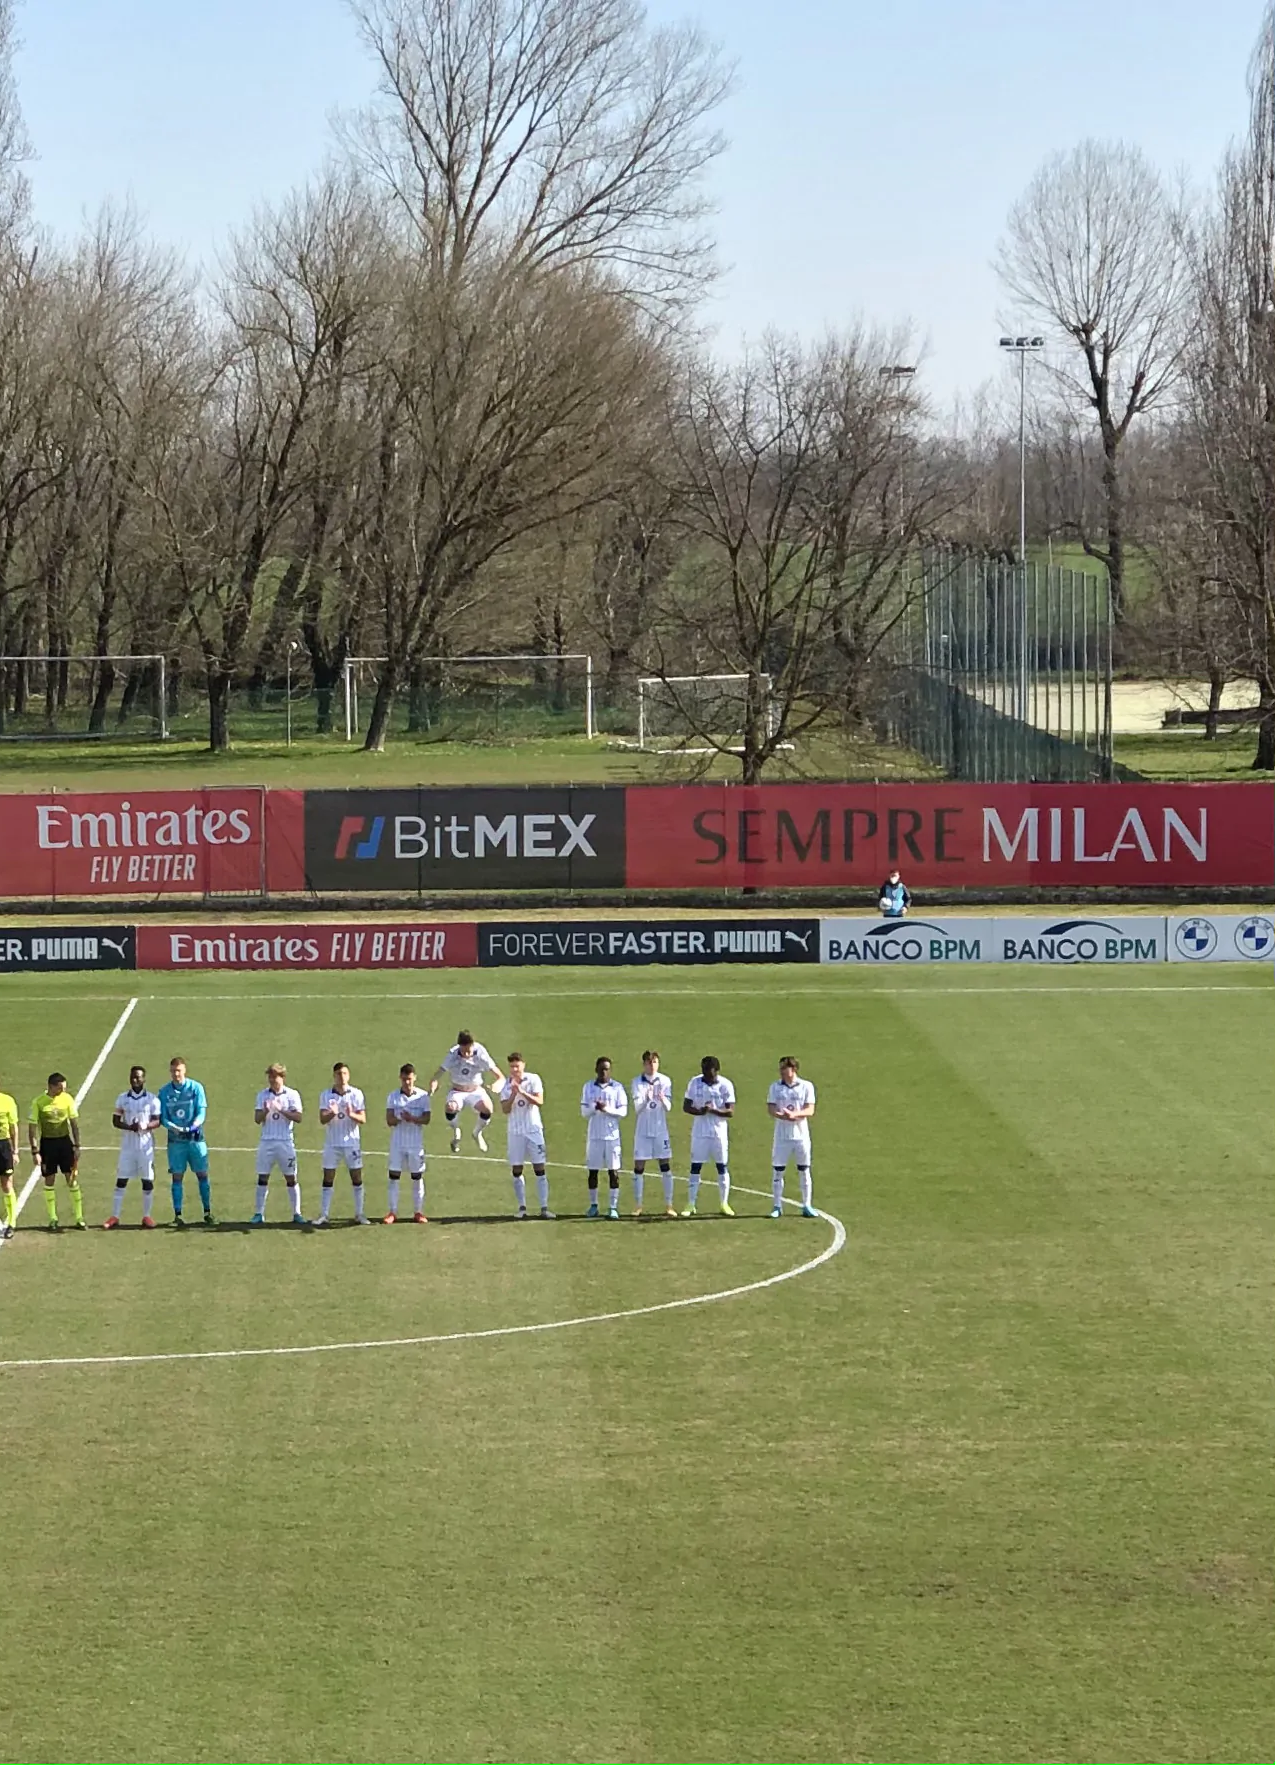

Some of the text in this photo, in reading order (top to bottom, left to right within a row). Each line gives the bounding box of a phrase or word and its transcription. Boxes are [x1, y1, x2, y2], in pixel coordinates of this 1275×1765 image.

[36, 801, 252, 849] Emirates
[394, 814, 597, 859] BitMEX
[693, 807, 1208, 863] SEMPRE MILAN
[90, 854, 197, 883] FLY BETTER
[31, 938, 98, 960] PUMA
[169, 931, 446, 962] Emirates FLY BETTER
[489, 933, 605, 956] FOREVER
[714, 931, 782, 953] PUMA
[829, 939, 981, 961] BANCO BPM
[1004, 938, 1157, 960] BANCO BPM
